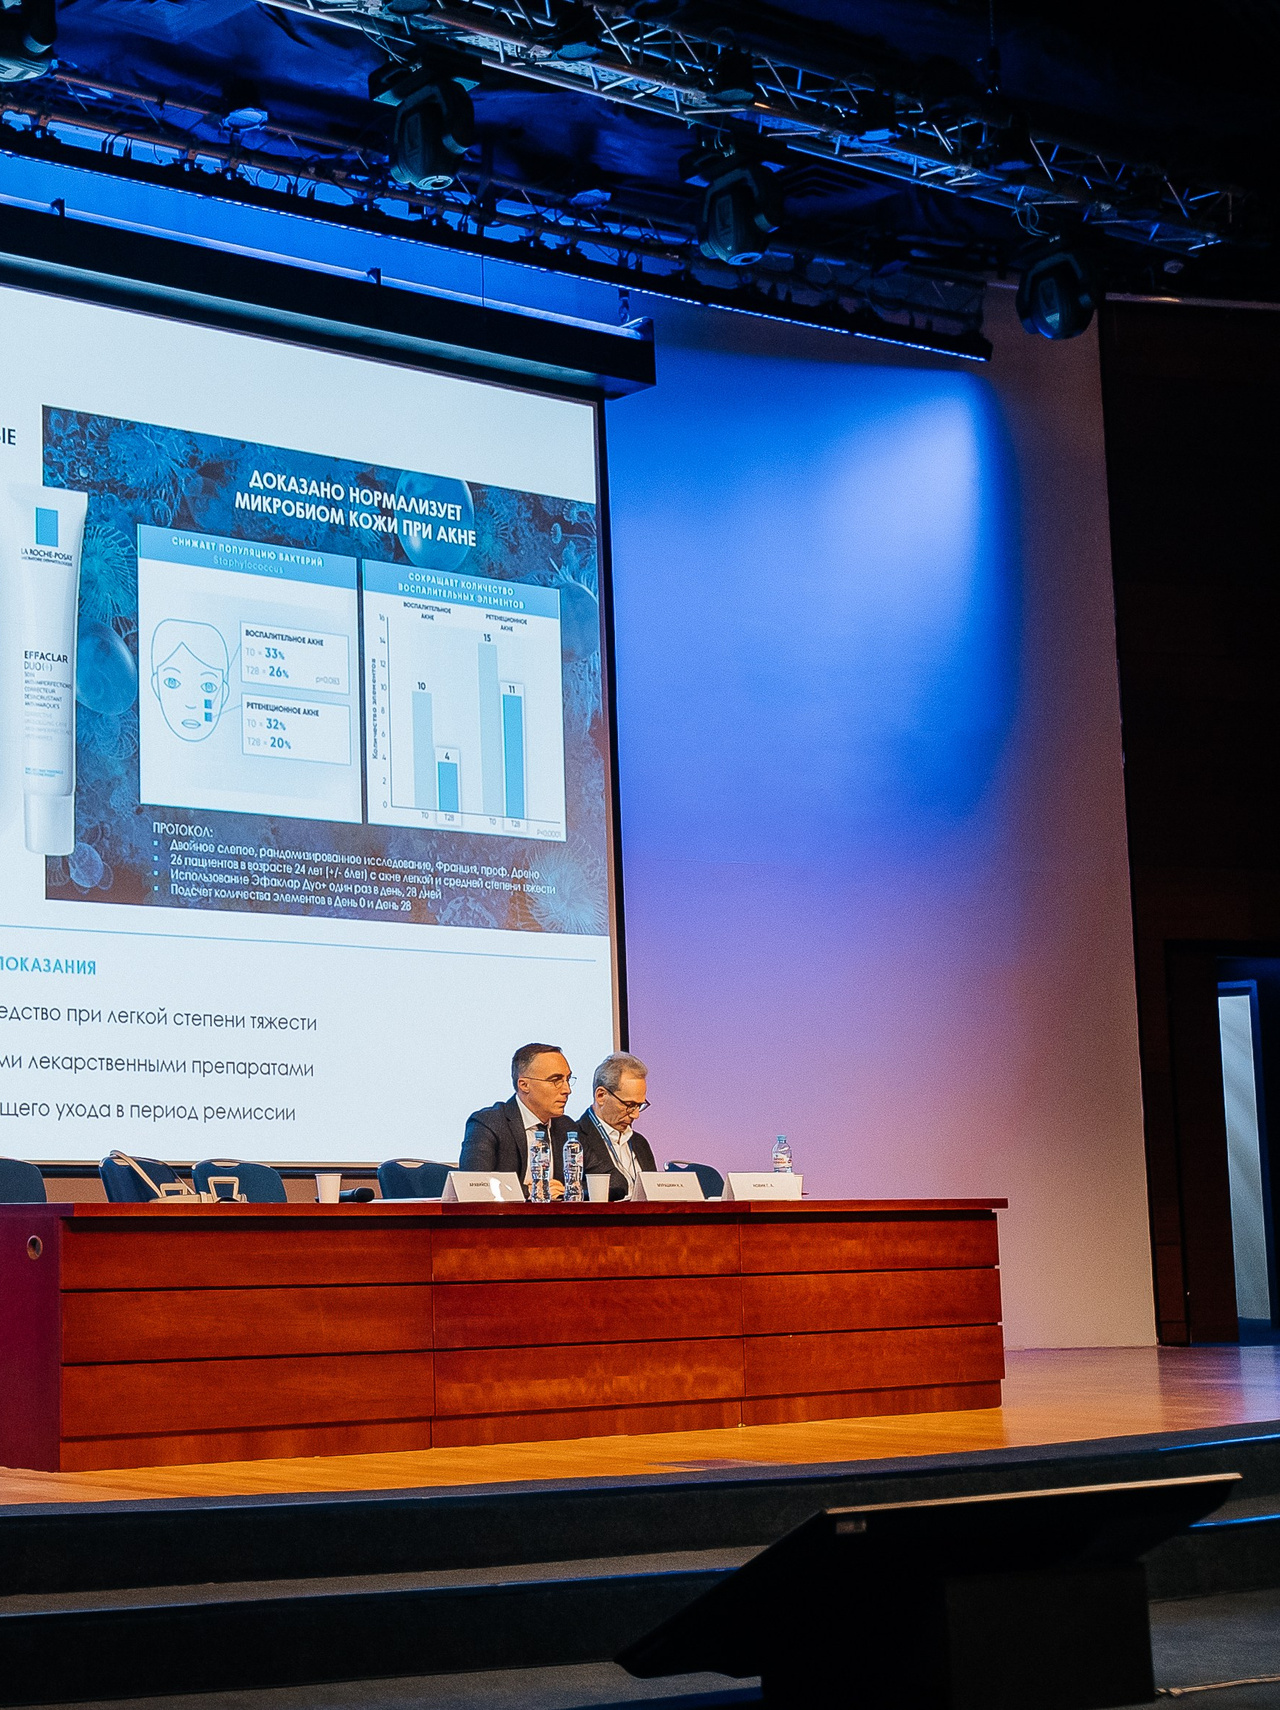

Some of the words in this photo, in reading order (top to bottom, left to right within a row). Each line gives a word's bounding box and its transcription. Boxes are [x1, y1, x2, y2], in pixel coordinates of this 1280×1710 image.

[249, 469, 345, 501] ДОКАЗАНО
[349, 486, 462, 521] НОРМАЛИЗУЕТ
[235, 491, 344, 525] МИКРОБИОМ
[349, 510, 398, 534] КОЖИ
[402, 519, 432, 541] ПРИ
[436, 525, 476, 547] АКНЕ
[171, 536, 215, 551] СНИЖАЕТ
[218, 543, 276, 560] ПОПУЛЯЦИЮ
[278, 552, 322, 567] БАКТЕРИЙ
[213, 555, 284, 574] Staphylococcus
[398, 582, 474, 602] ВОСПАЛИТЕЛЬНЫХ
[477, 594, 523, 609] ЭЛЕМЕНТОВ
[460, 580, 513, 596] КОЛИЧЕСТВО
[403, 601, 452, 615] ВОСПАЛИТЕЛЬНОЕ
[245, 629, 306, 644] ВОСПАЛИТЕЛЬНОЕ
[307, 637, 323, 646] АКНЕ
[483, 633, 491, 642] 15
[24, 650, 69, 664] EFFACLAR
[264, 646, 285, 660] 33%
[269, 665, 289, 679] 26%
[417, 681, 426, 691] 10
[508, 685, 516, 694] 11
[302, 708, 319, 717] АКНЕ
[266, 717, 286, 731] 32%
[270, 736, 291, 749] 20%
[153, 821, 213, 837] ПРОТОКОЛ:
[67, 1008, 101, 1026] при
[107, 1007, 167, 1025] легкой
[173, 1012, 245, 1028] степени
[250, 1015, 316, 1030] тяжести
[28, 1055, 186, 1074] лекарственными
[192, 1060, 313, 1079] препаратами
[55, 1103, 110, 1121] ухода
[116, 1104, 124, 1118] в
[130, 1104, 198, 1122] период
[203, 1105, 295, 1123] ремиссии
